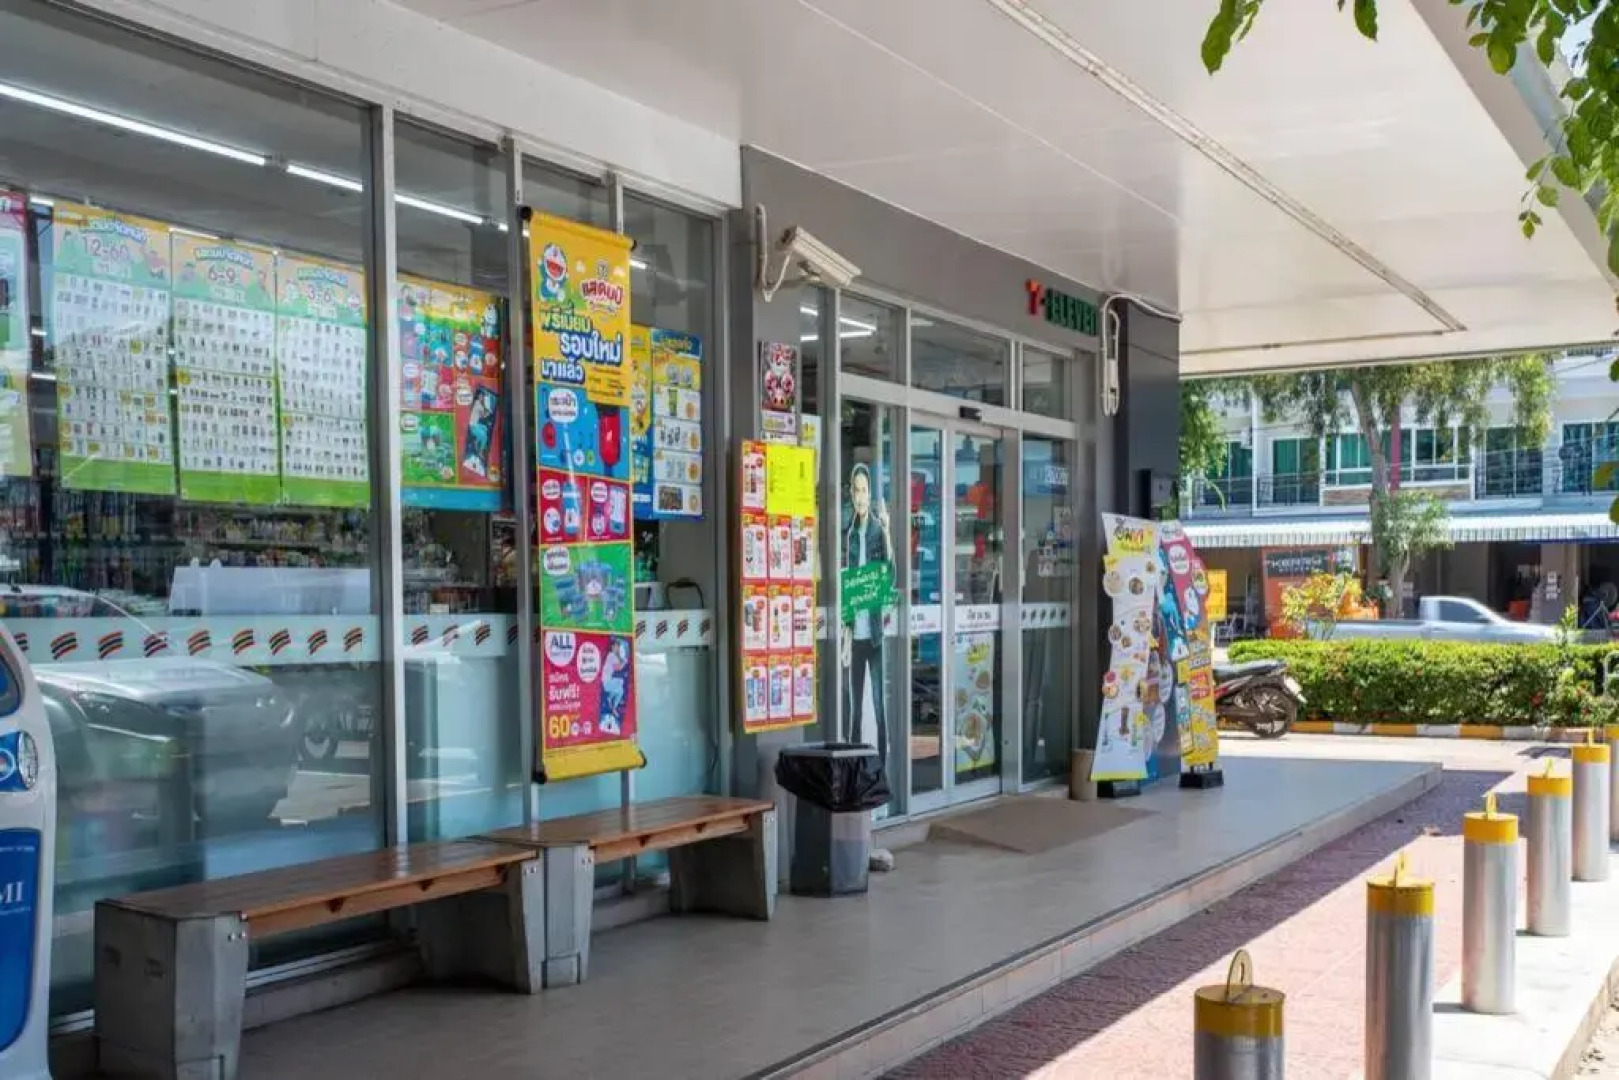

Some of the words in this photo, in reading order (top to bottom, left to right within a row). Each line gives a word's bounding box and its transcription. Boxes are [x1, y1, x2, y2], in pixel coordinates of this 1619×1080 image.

[560, 330, 622, 364] รอบใหม่
[541, 357, 585, 383] มาแล้ว
[551, 633, 573, 649] ALL
[549, 714, 571, 739] 60
